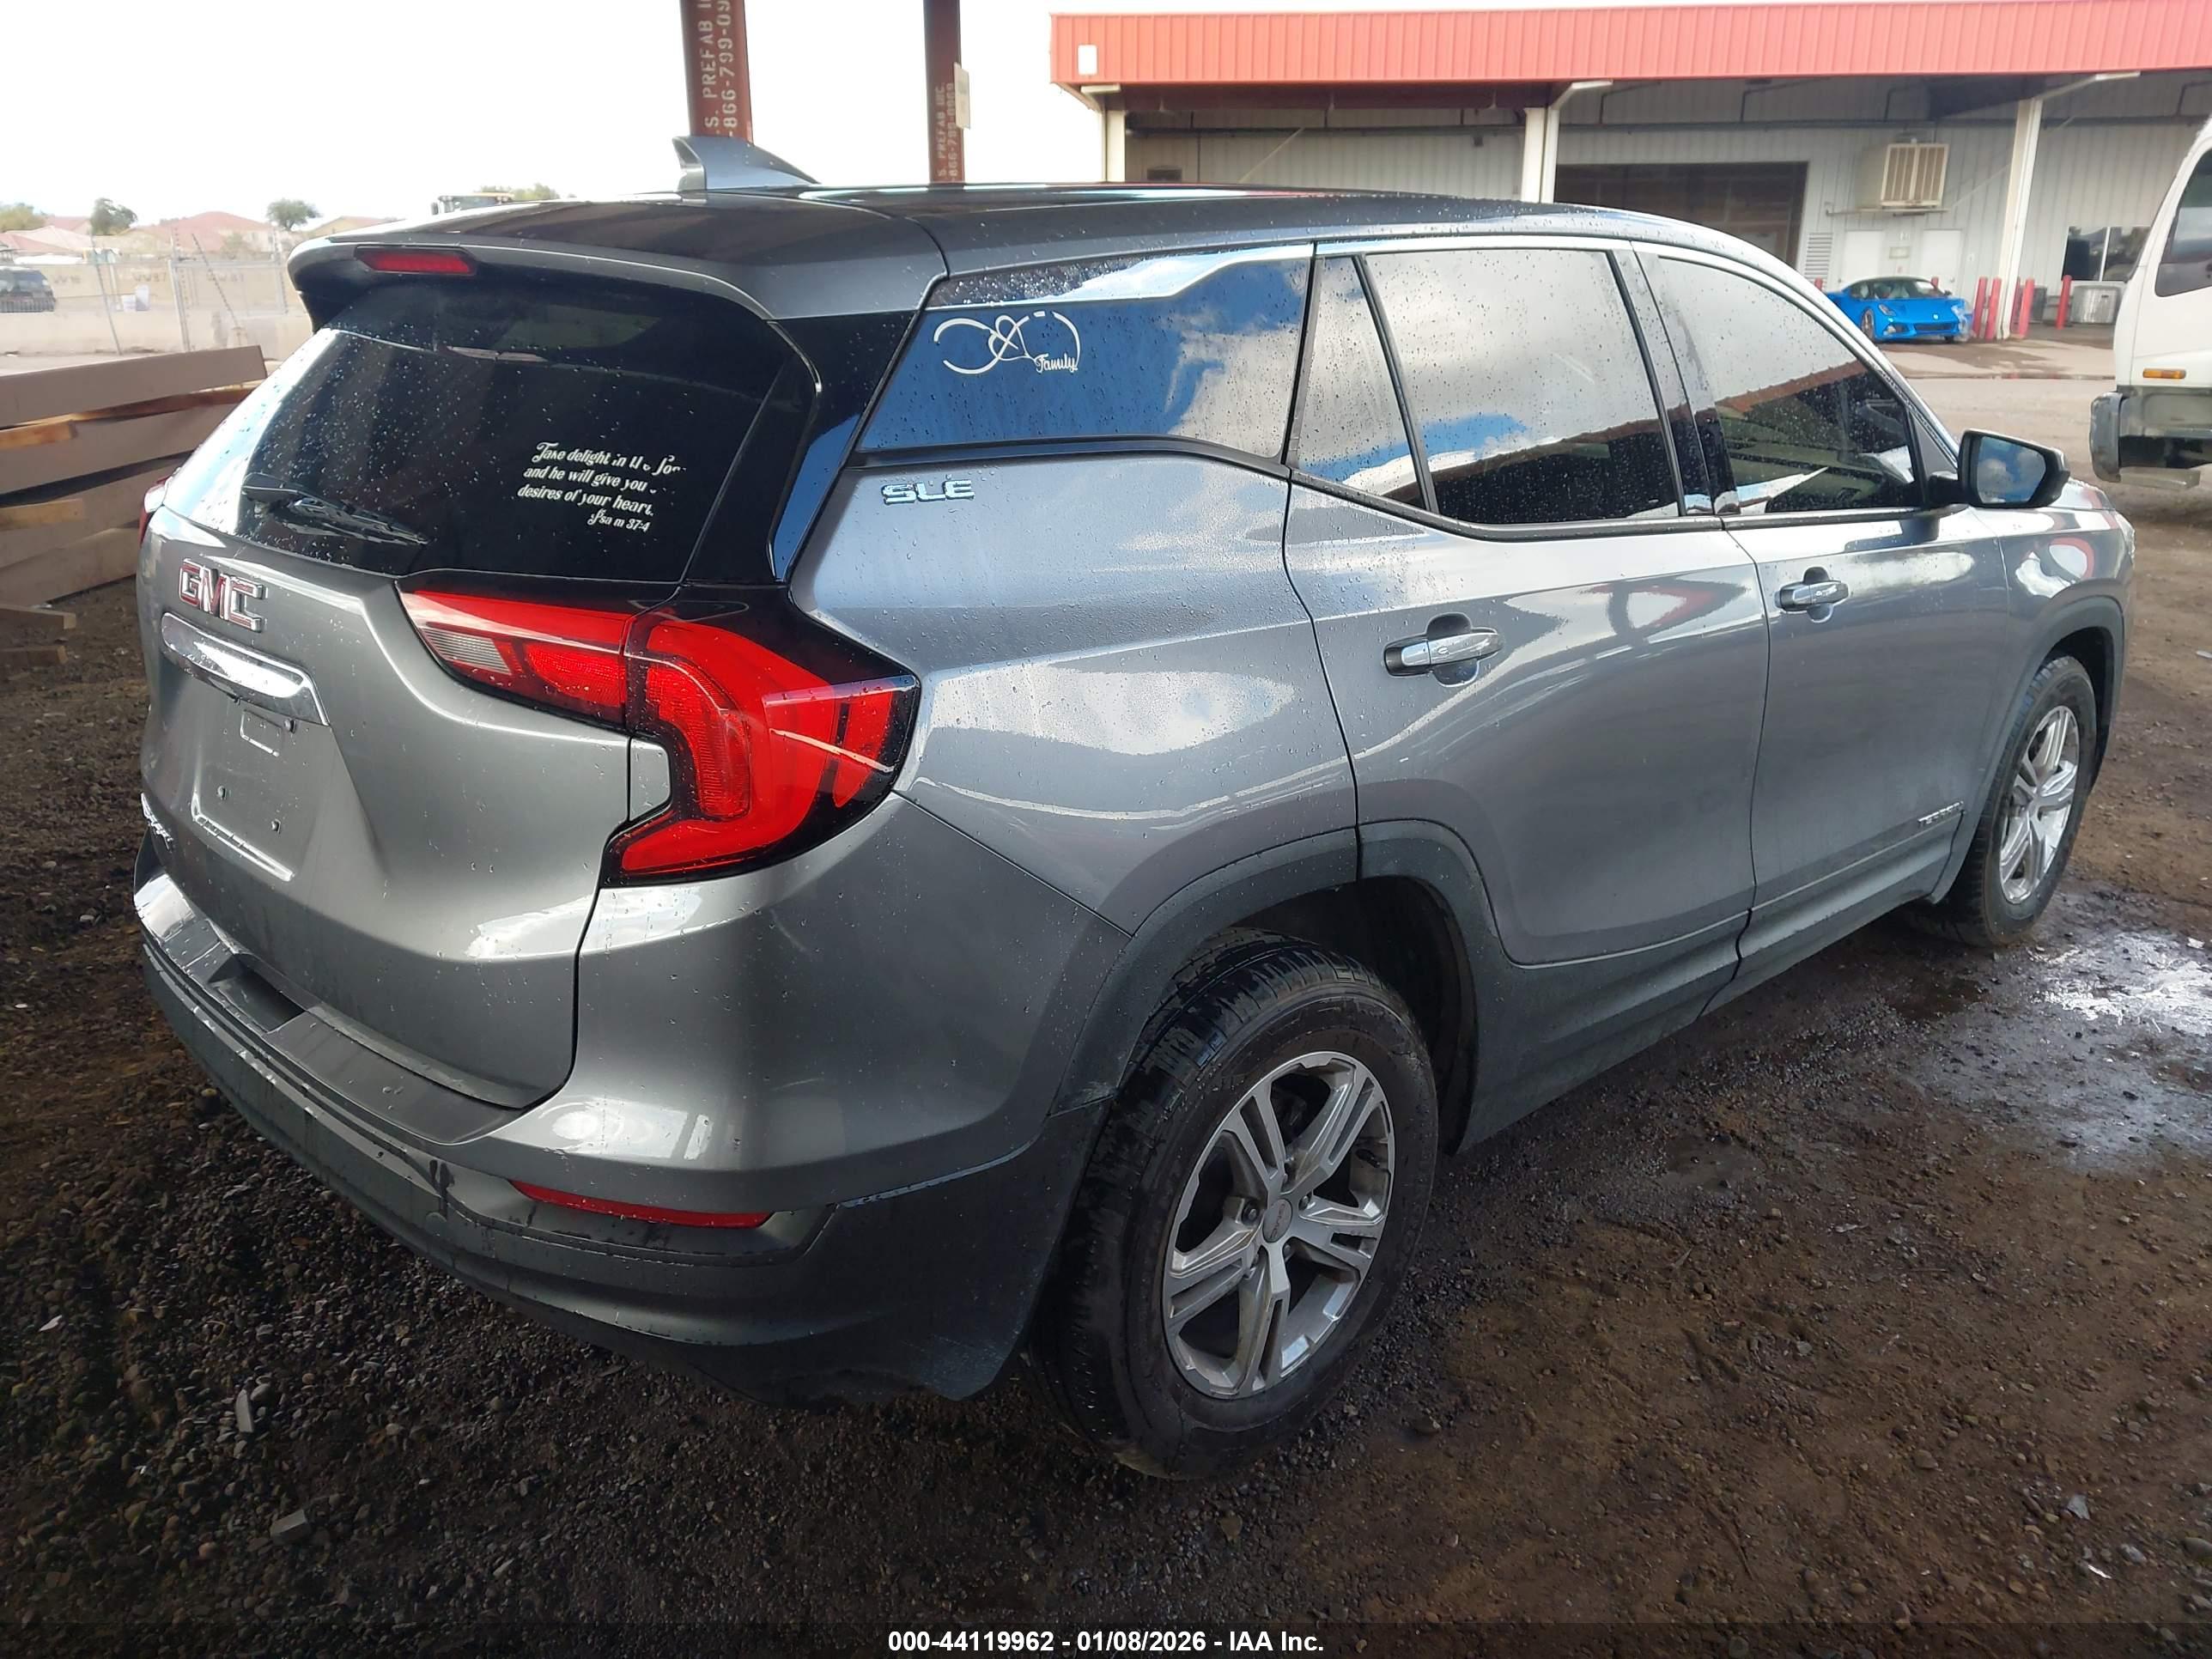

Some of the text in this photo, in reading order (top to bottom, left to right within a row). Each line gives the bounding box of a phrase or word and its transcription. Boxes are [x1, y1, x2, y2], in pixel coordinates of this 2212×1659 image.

[697, 20, 718, 99] PREFAB
[1034, 352, 1079, 373] Family
[566, 447, 612, 467] delight
[611, 453, 627, 467] in
[651, 454, 687, 477] Lor
[523, 465, 550, 480] and
[547, 465, 566, 481] he
[568, 469, 595, 483] will
[590, 472, 622, 488] give
[619, 478, 648, 492] you
[517, 483, 563, 501] desires
[563, 488, 583, 502] of
[577, 494, 612, 507] your
[881, 480, 975, 505] SLE
[586, 507, 651, 532] Psam 37:4
[179, 558, 265, 634] GMC
